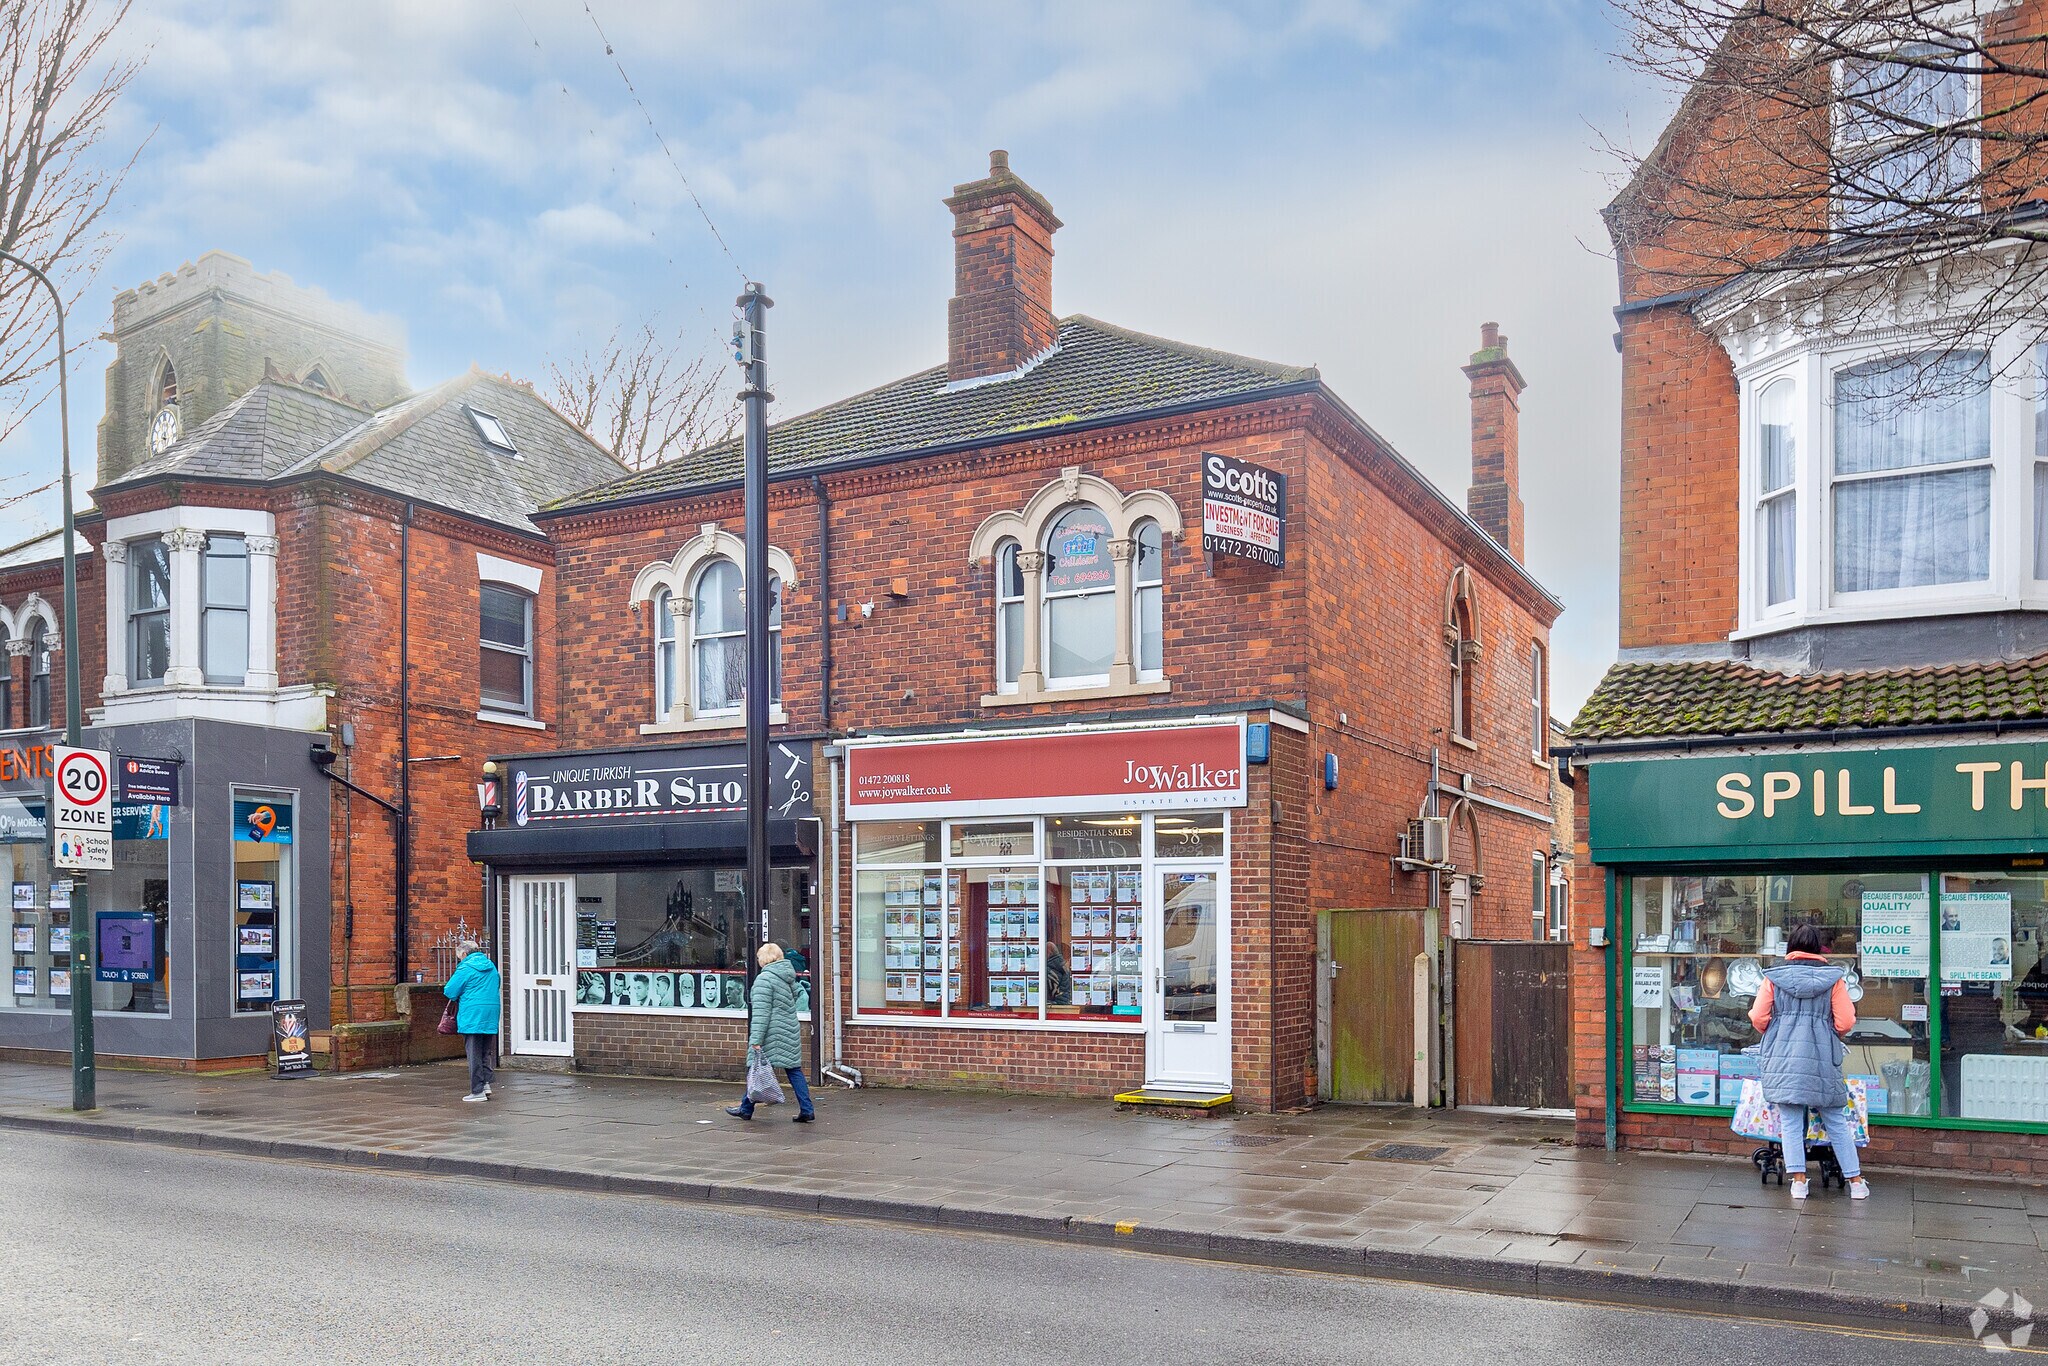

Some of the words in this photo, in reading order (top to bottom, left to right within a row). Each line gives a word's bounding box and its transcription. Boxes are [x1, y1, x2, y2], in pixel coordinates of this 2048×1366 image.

[1206, 456, 1278, 505] Scotts
[1215, 523, 1244, 538] BUSINESS
[1253, 513, 1265, 533] FOR
[1265, 517, 1279, 537] SALE
[1204, 535, 1242, 556] 01472
[1246, 543, 1280, 567] 267000
[66, 768, 101, 792] 20
[552, 767, 590, 784] UNIQUE
[592, 765, 631, 781] TURKISH
[858, 775, 881, 785] 01472
[883, 773, 910, 784] 200818
[858, 783, 952, 799] www.joywalker.co.uk
[1955, 760, 2048, 811] TH
[127, 792, 155, 801] Available
[530, 779, 662, 813] BARBER
[670, 776, 771, 806] SHO
[1715, 766, 1922, 820] SPILL
[1123, 798, 1173, 806] ESTATE
[60, 808, 106, 824] ZONE
[121, 805, 150, 816] SERVICE
[17, 817, 37, 828] MORE
[901, 833, 935, 842] LETTINGS
[1056, 829, 1107, 838] RESIDENTIAL
[1108, 828, 1133, 837] SALES
[1179, 826, 1200, 845] 58
[85, 837, 110, 845] School
[87, 846, 108, 856] Safety
[1863, 892, 1893, 900] BECAUSE
[1892, 892, 1902, 900] IT'S
[1940, 893, 1967, 901] BECAUSE
[1967, 893, 1979, 901] IT'S
[1979, 893, 2010, 901] PERSONAL
[1863, 901, 1912, 912] QUALITY
[1863, 925, 1912, 935] CHOICE
[1863, 945, 1911, 955] VALUE
[1120, 960, 1138, 968] open
[101, 970, 119, 979] TOUCH
[130, 971, 149, 980] SCREEN
[1870, 969, 1887, 977] SPILL
[1887, 969, 1899, 977] THE
[1900, 968, 1921, 976] BEANS
[1950, 971, 1967, 980] SPILL
[1967, 971, 1980, 980] THE
[1980, 971, 2002, 980] BEANS
